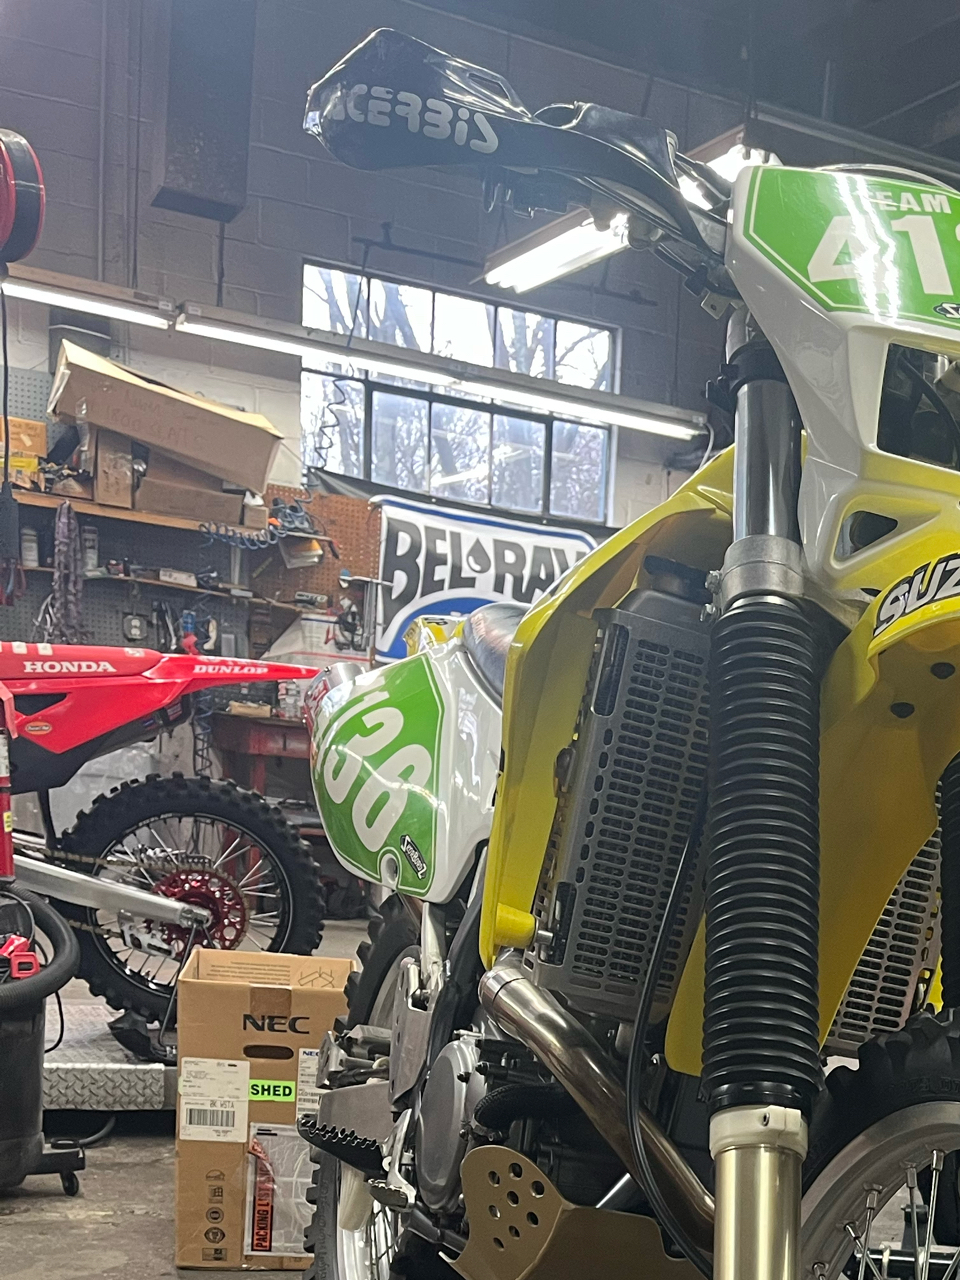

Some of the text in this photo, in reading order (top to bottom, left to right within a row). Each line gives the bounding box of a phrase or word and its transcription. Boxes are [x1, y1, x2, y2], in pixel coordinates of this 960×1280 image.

[23, 660, 118, 673] HONDA
[192, 665, 269, 675] DUNLOP
[243, 1014, 310, 1035] NEC
[250, 1084, 293, 1097] SHED
[255, 1207, 269, 1250] PACKING
